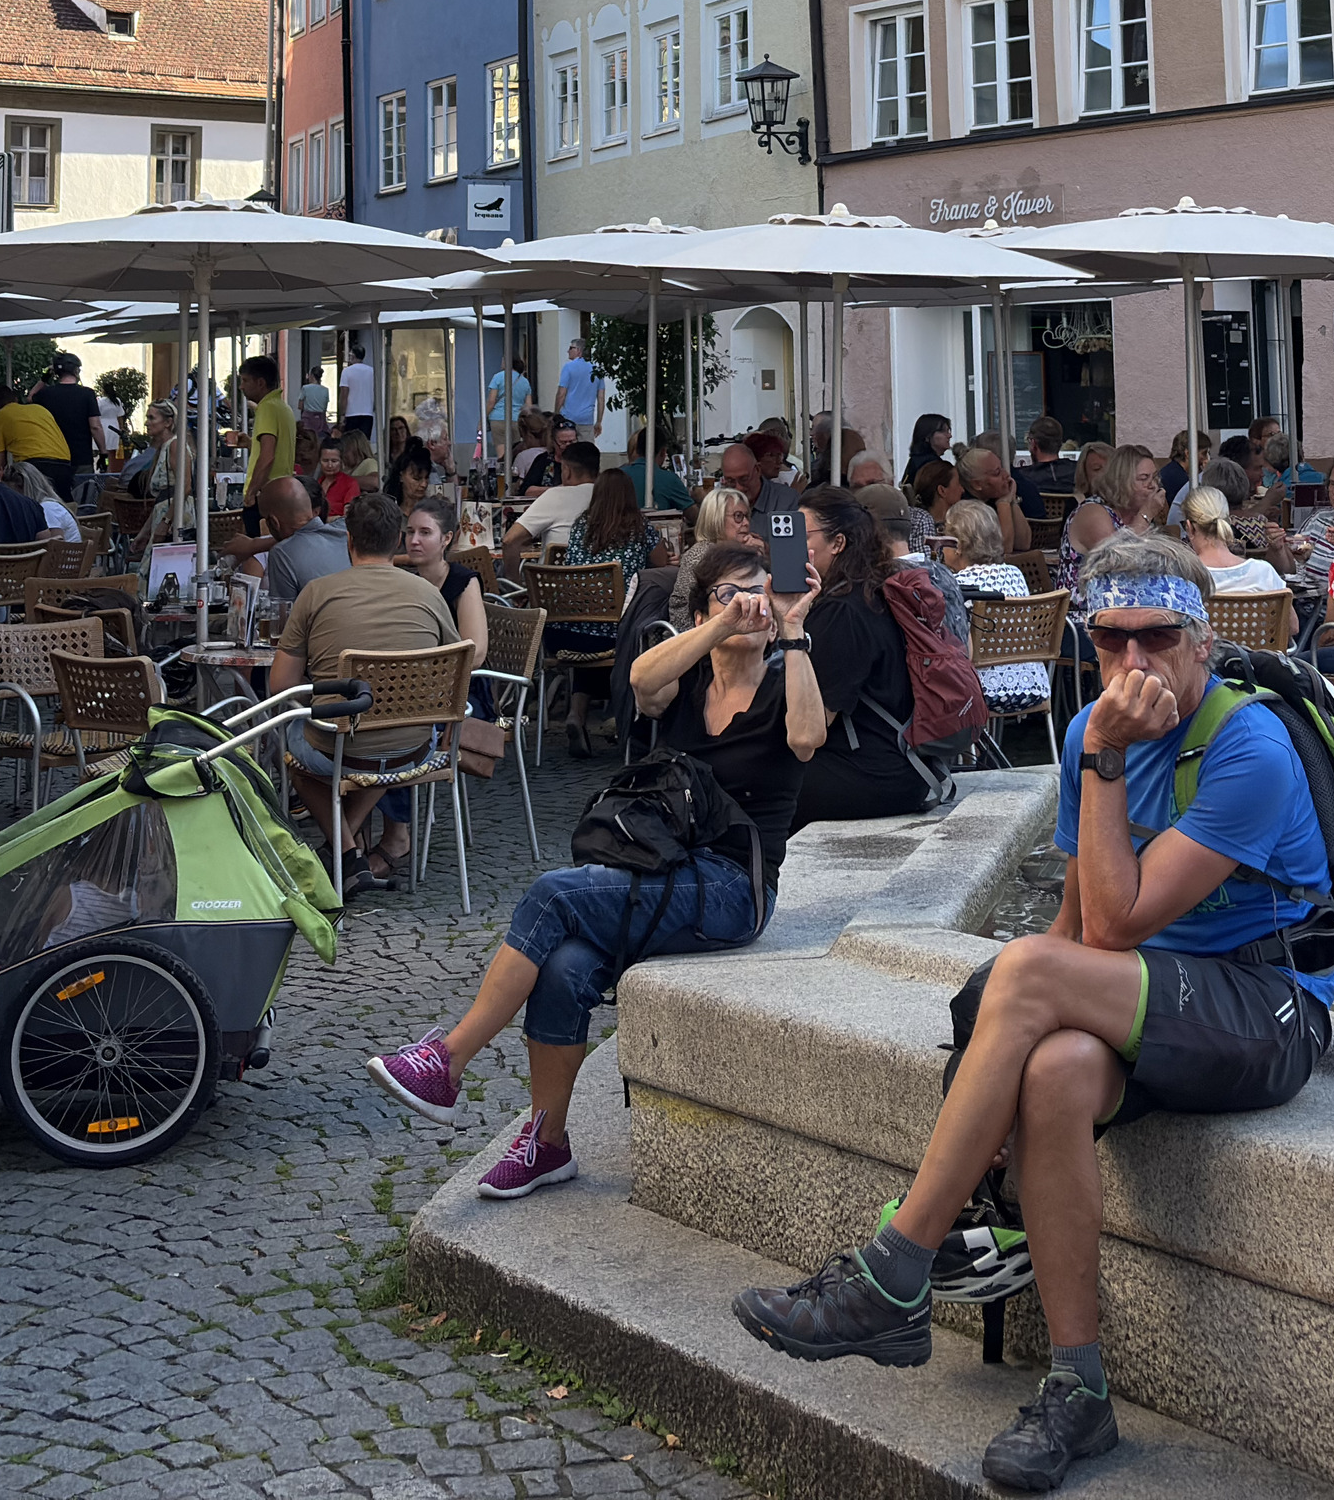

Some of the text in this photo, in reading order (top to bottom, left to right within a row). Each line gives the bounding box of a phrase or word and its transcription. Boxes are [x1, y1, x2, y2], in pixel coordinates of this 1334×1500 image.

[929, 190, 1054, 224] Franz & Xaver
[191, 900, 242, 909] CROOZER
